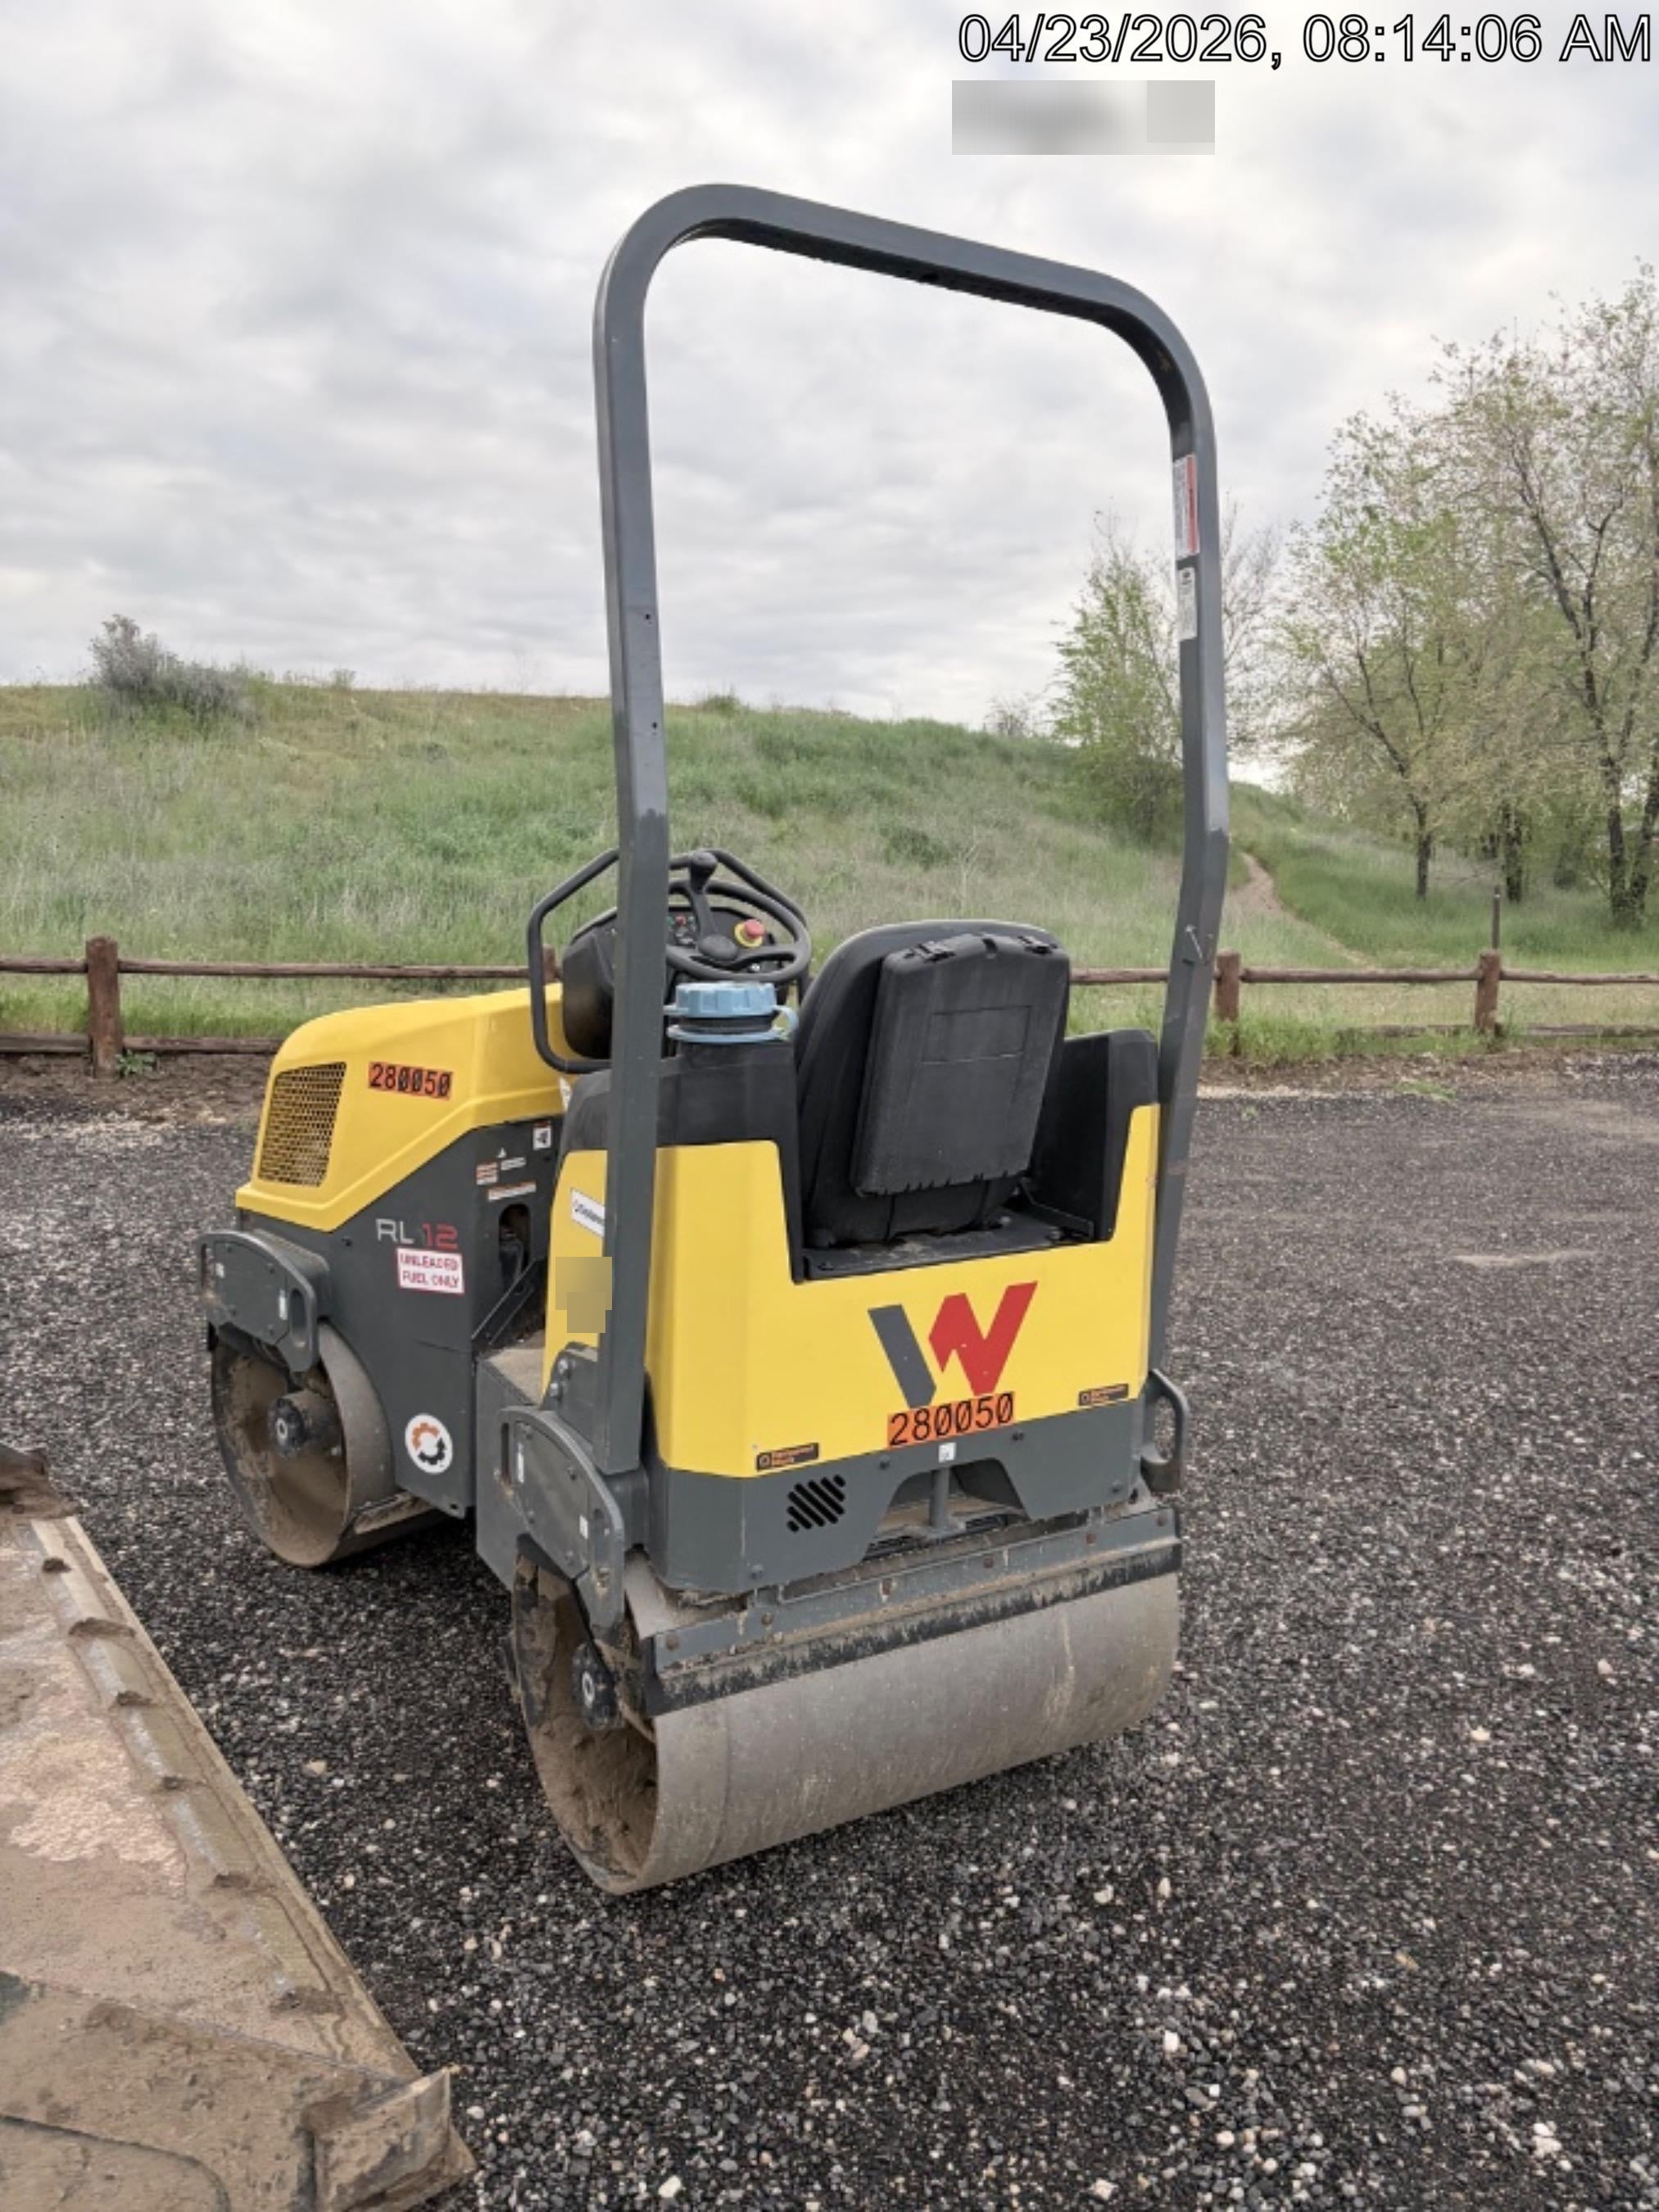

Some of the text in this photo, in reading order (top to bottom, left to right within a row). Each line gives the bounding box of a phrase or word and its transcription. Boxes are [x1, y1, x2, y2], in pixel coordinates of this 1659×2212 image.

[369, 1063, 451, 1097] 280050
[376, 1218, 459, 1249] RL 12
[399, 1253, 459, 1271] UNLEADED
[402, 1271, 460, 1289] FUEL ONLY
[889, 1392, 1014, 1447] 280050
